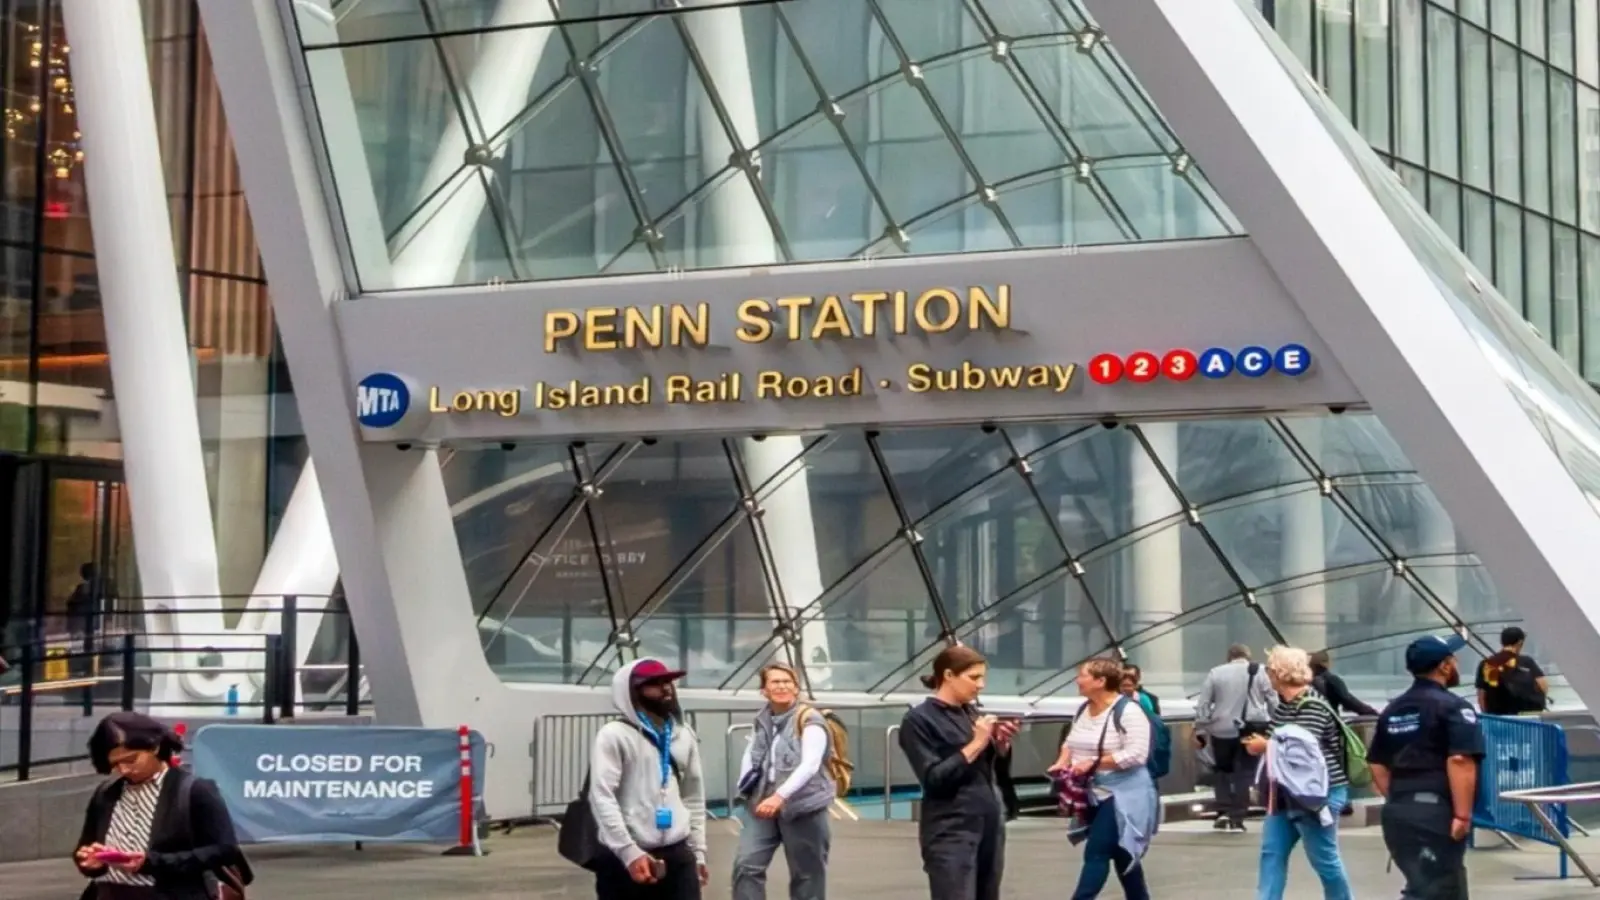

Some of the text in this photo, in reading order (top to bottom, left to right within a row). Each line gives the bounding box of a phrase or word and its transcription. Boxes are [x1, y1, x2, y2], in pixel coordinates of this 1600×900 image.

[544, 284, 1012, 353] PENN STATION
[357, 385, 399, 417] MTA
[429, 386, 521, 417] Long
[535, 376, 650, 409] Island
[667, 371, 742, 404] Rail
[757, 366, 863, 399] Road
[907, 361, 1077, 393] Subway
[256, 753, 422, 774] CLOSED FOR
[243, 779, 434, 799] MAINTENANCE
